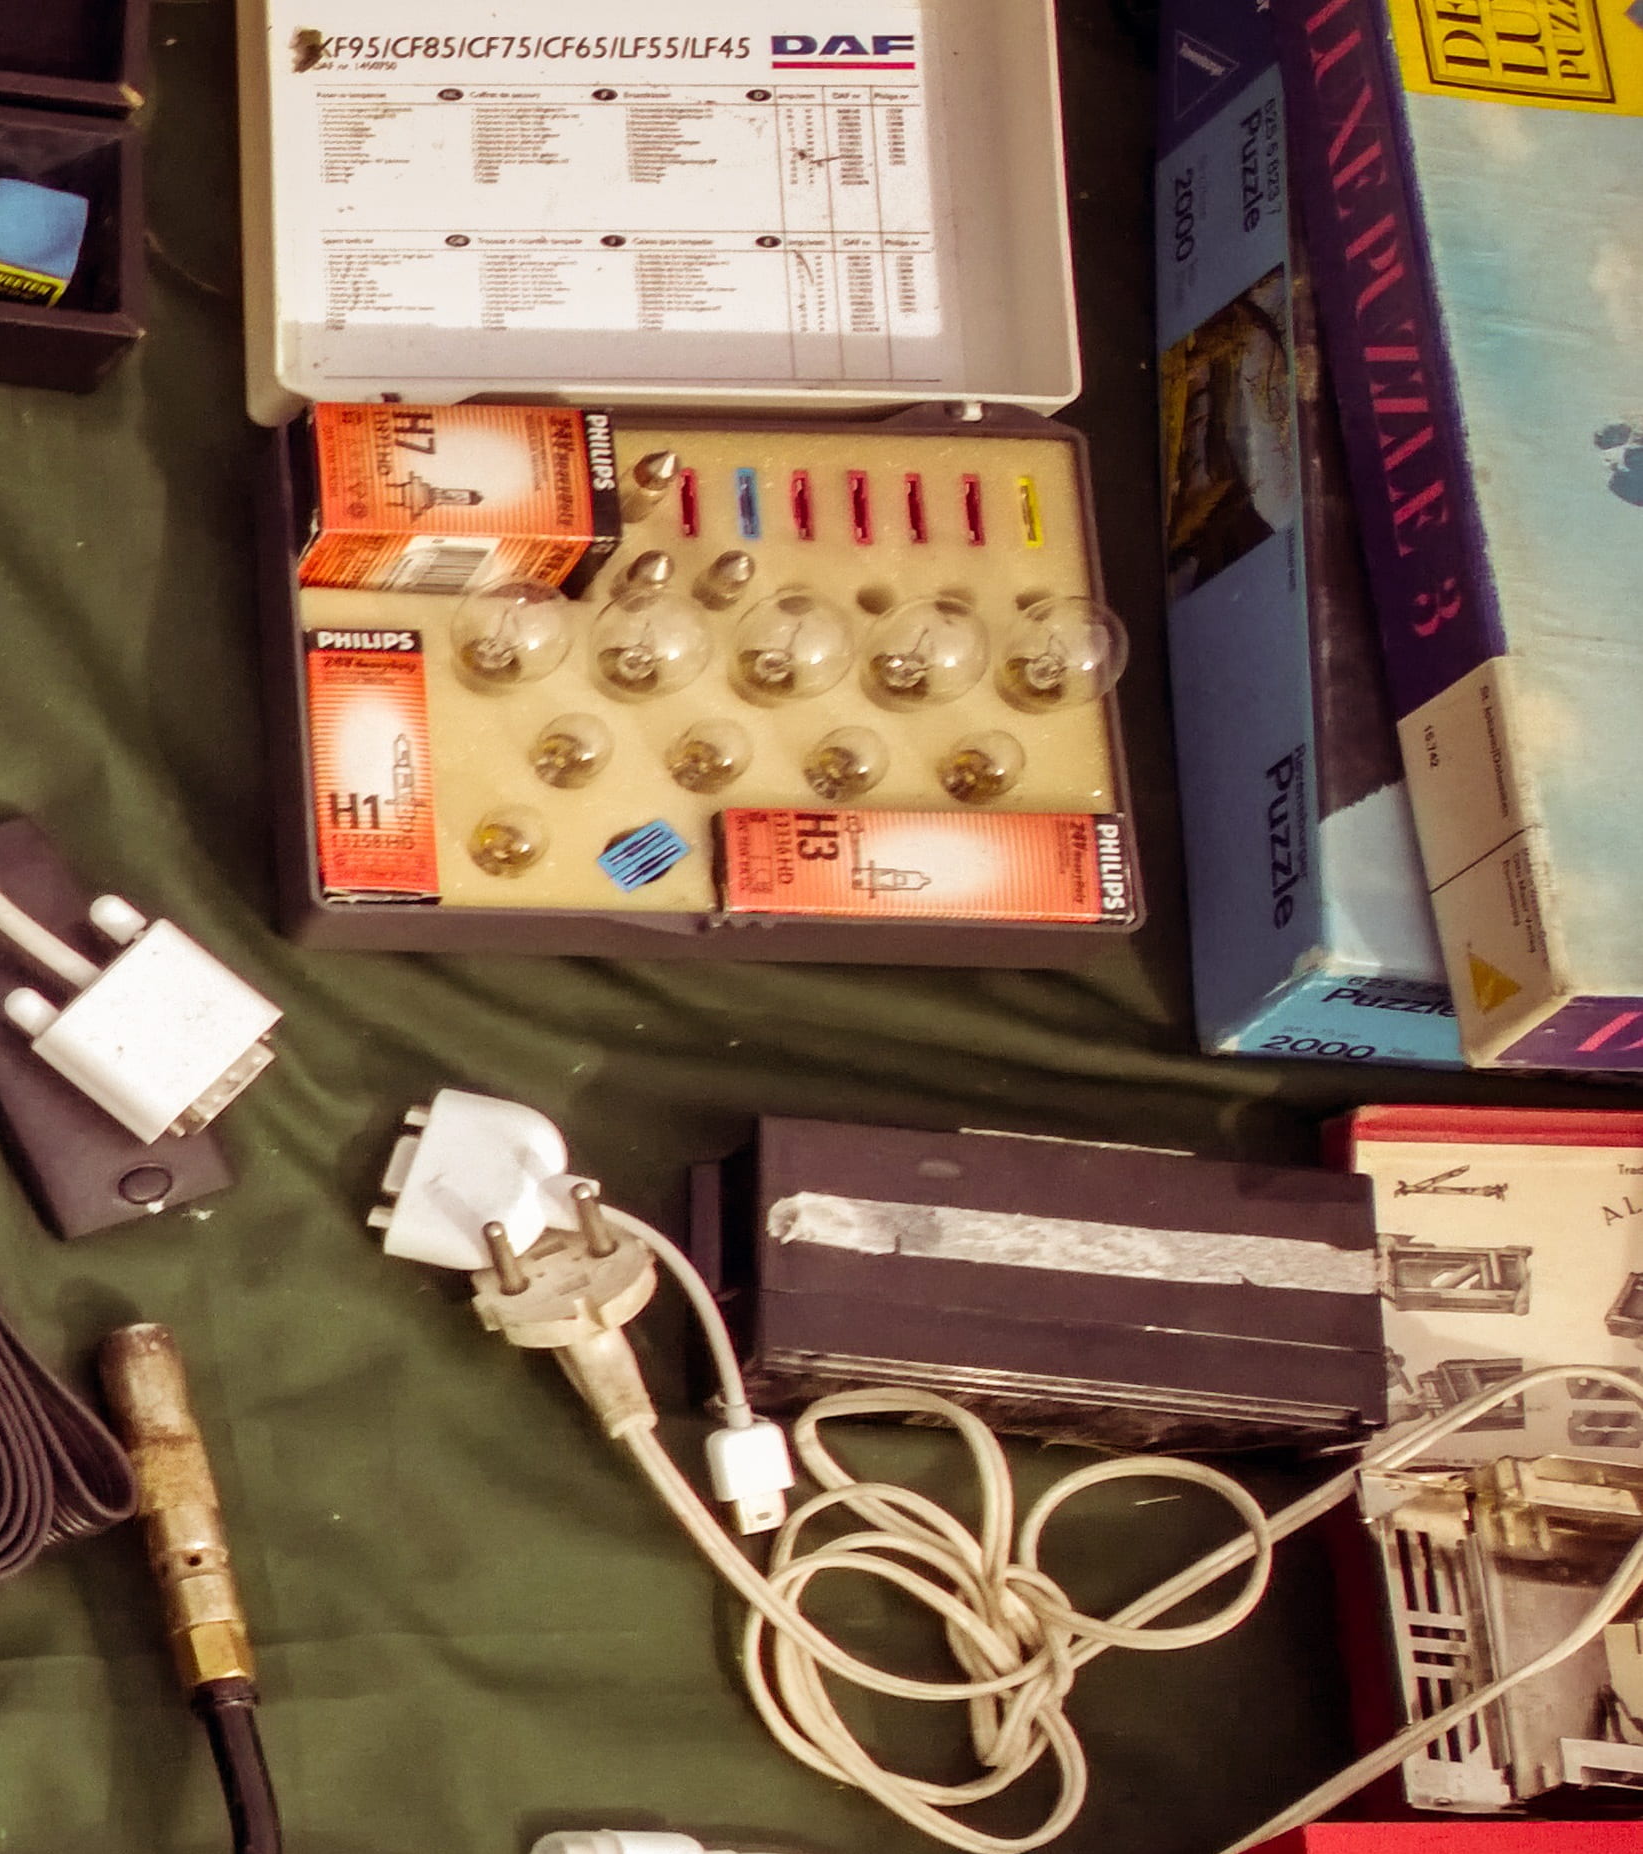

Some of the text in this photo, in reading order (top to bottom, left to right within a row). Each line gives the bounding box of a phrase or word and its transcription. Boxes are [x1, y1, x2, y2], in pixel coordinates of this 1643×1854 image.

[771, 34, 915, 56] DAF
[1239, 108, 1263, 232] Puzzle
[1172, 168, 1194, 262] 2000
[392, 411, 437, 455] H7
[585, 413, 616, 492] PHILIPS
[1345, 211, 1451, 558] PUZZLE
[1412, 577, 1462, 638] 3
[317, 631, 415, 651] PHILIPS
[330, 792, 381, 829] H1
[794, 812, 840, 862] H3
[1264, 753, 1292, 929] Puzzle
[1096, 823, 1127, 911] PHILIPS
[1259, 1033, 1375, 1059] 2000
